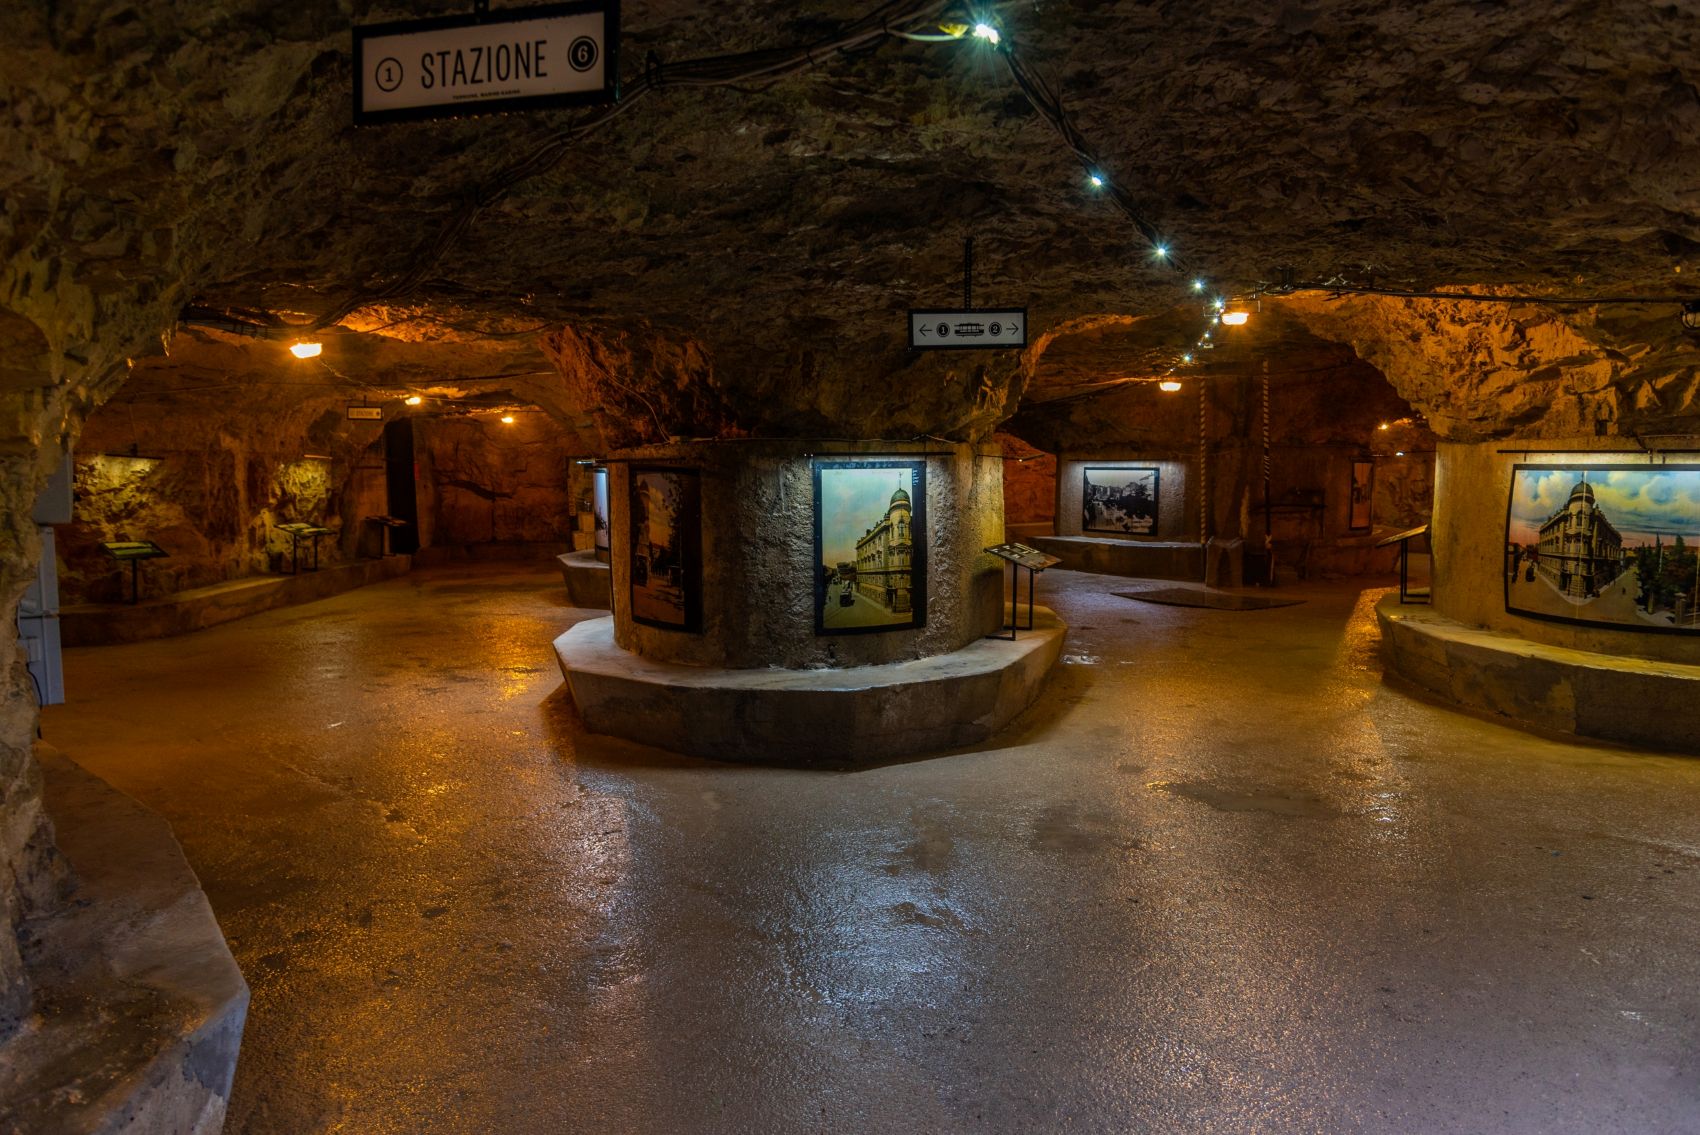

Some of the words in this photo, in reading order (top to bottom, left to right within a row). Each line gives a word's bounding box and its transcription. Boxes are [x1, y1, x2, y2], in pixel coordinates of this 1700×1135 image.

[384, 67, 394, 82] 1
[420, 40, 548, 89] STAZIONE
[577, 45, 588, 63] 6
